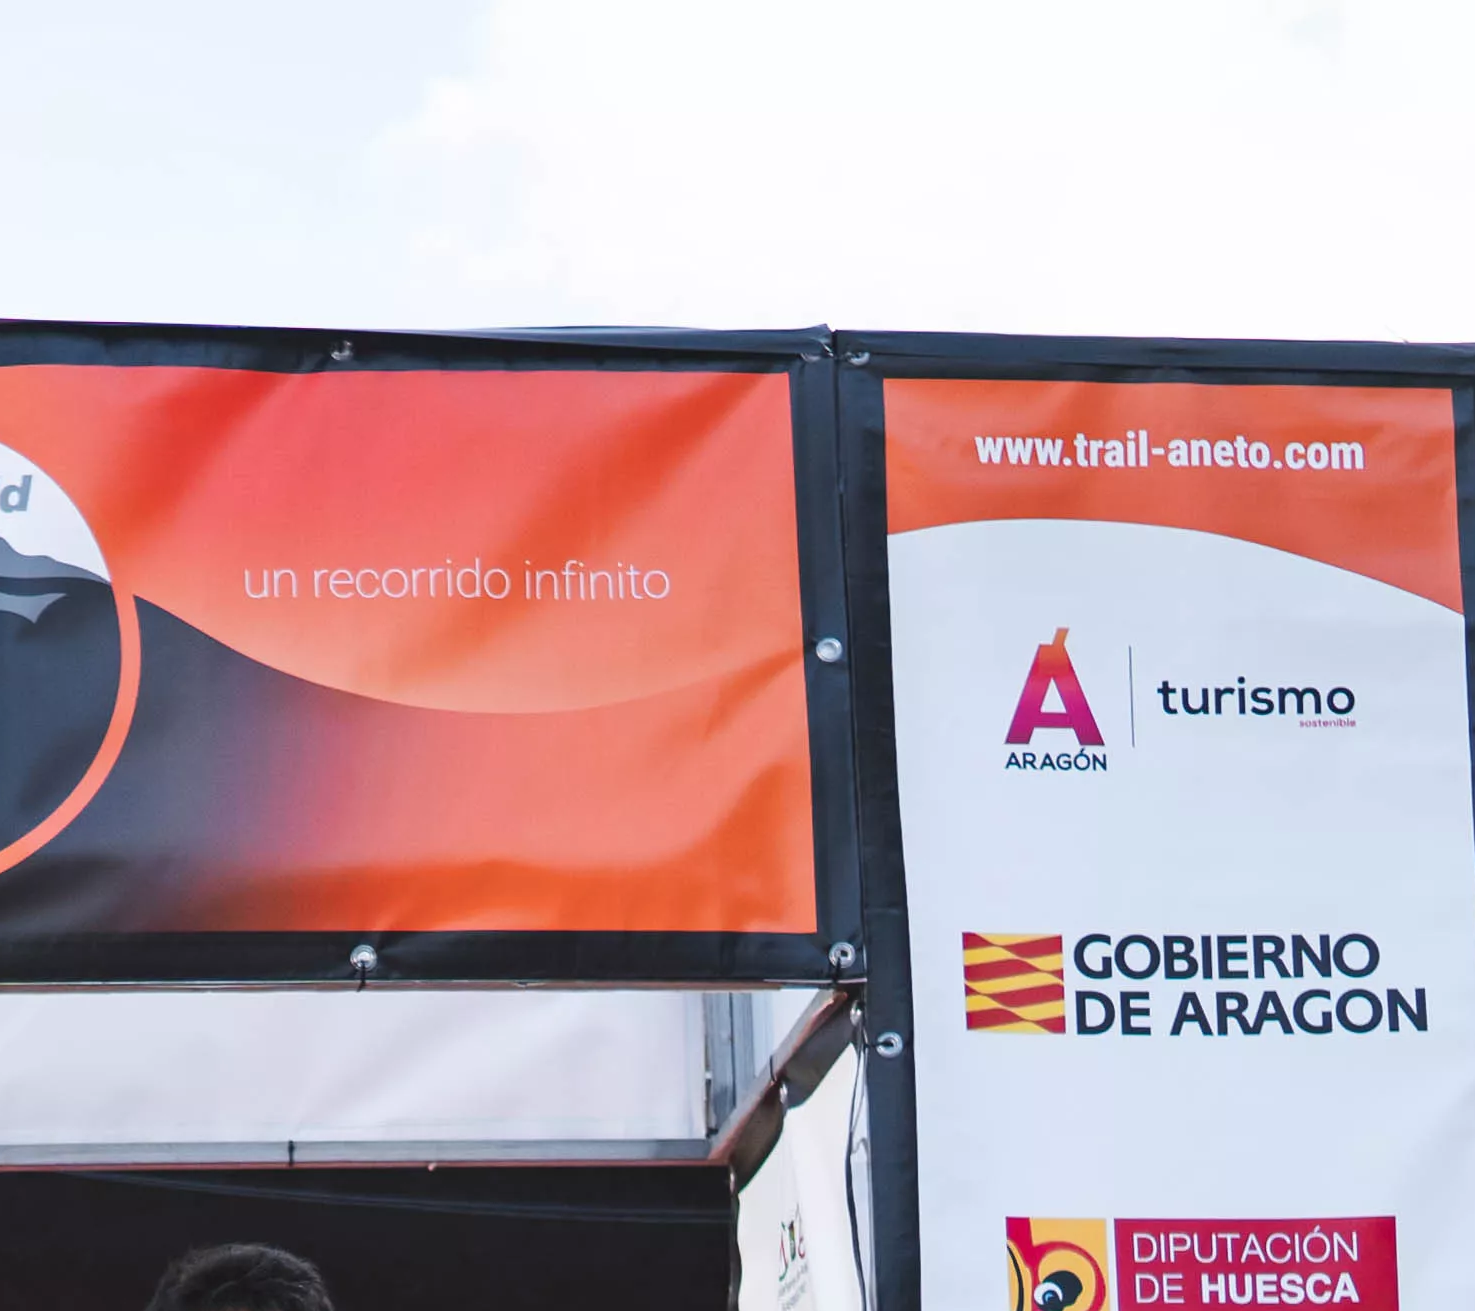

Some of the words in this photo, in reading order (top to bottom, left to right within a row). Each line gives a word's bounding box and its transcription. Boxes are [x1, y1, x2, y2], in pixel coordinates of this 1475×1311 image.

[975, 430, 1365, 470] www.trail-aneto.com
[244, 564, 297, 600] un
[313, 557, 511, 600] recorrido
[524, 558, 671, 600] infinito
[1157, 676, 1356, 717] turismo
[1298, 717, 1357, 729] sostenible
[1005, 747, 1107, 772] ARAGÓN
[1073, 933, 1381, 981] GOBIERNO
[1075, 989, 1152, 1037] DE
[1170, 988, 1429, 1037] ARAGON
[1133, 1226, 1359, 1264] DIPUTACIÓN
[1134, 1273, 1184, 1304] DE
[1201, 1272, 1360, 1305] HUESCA
